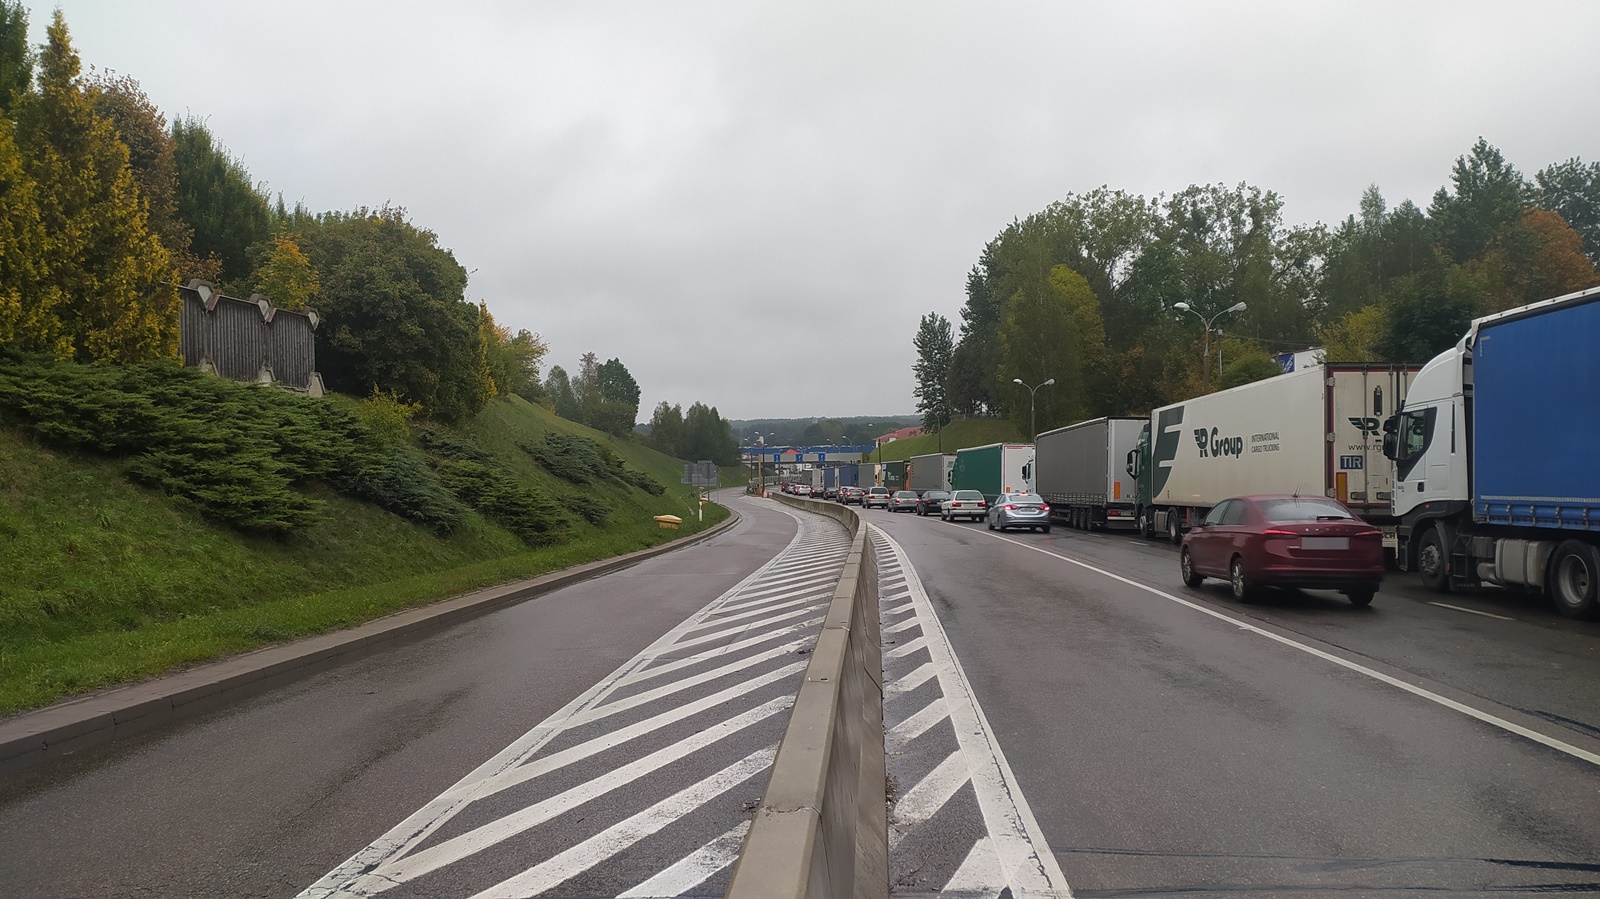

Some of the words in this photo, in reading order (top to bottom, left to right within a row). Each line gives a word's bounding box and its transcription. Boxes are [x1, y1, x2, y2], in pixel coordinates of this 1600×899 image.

[1210, 426, 1243, 459] Group
[1251, 431, 1280, 443] INTERNATIONAL
[1251, 444, 1263, 454] CARGO
[1263, 442, 1280, 453] TRUCKING
[1341, 456, 1362, 468] TIR
